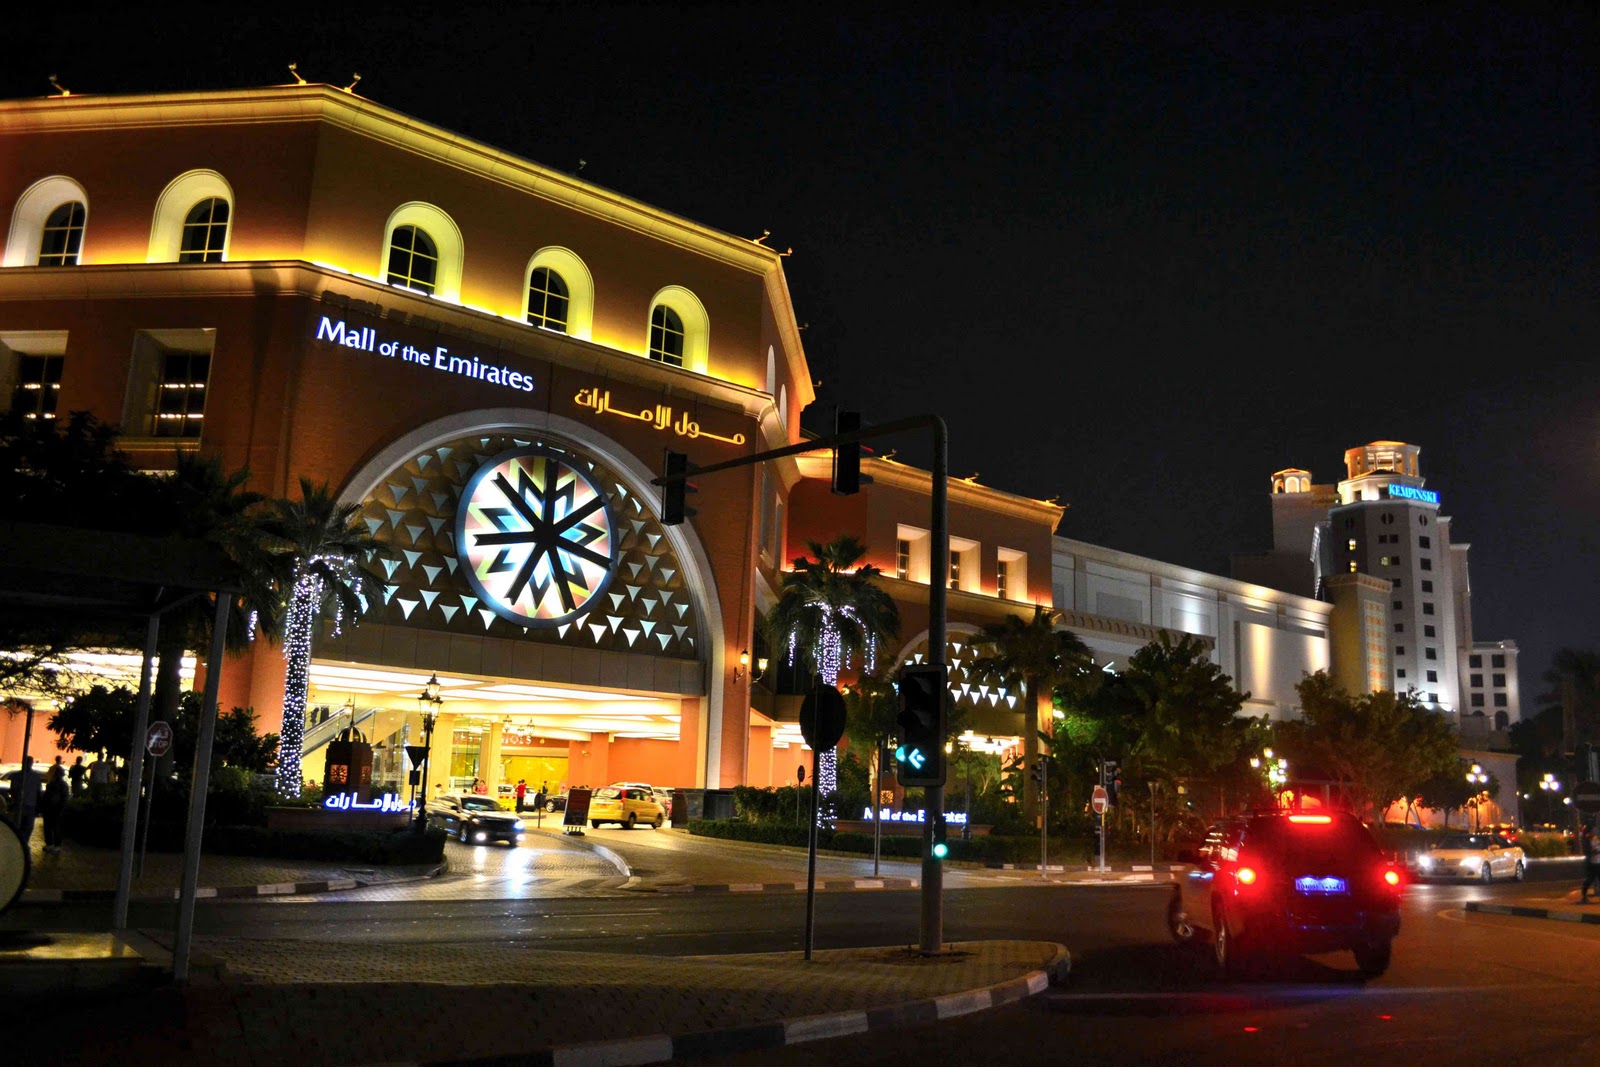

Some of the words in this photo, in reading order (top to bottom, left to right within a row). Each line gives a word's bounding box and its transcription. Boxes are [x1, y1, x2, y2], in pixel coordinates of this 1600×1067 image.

[316, 316, 376, 352] Mall
[379, 341, 399, 357] of
[402, 345, 431, 366] the
[434, 346, 534, 392] Emirates
[674, 411, 746, 445] مول
[1388, 483, 1438, 504] KEMPINSKI
[891, 811, 902, 821] of
[902, 811, 917, 822] the
[917, 809, 967, 823] Eates
